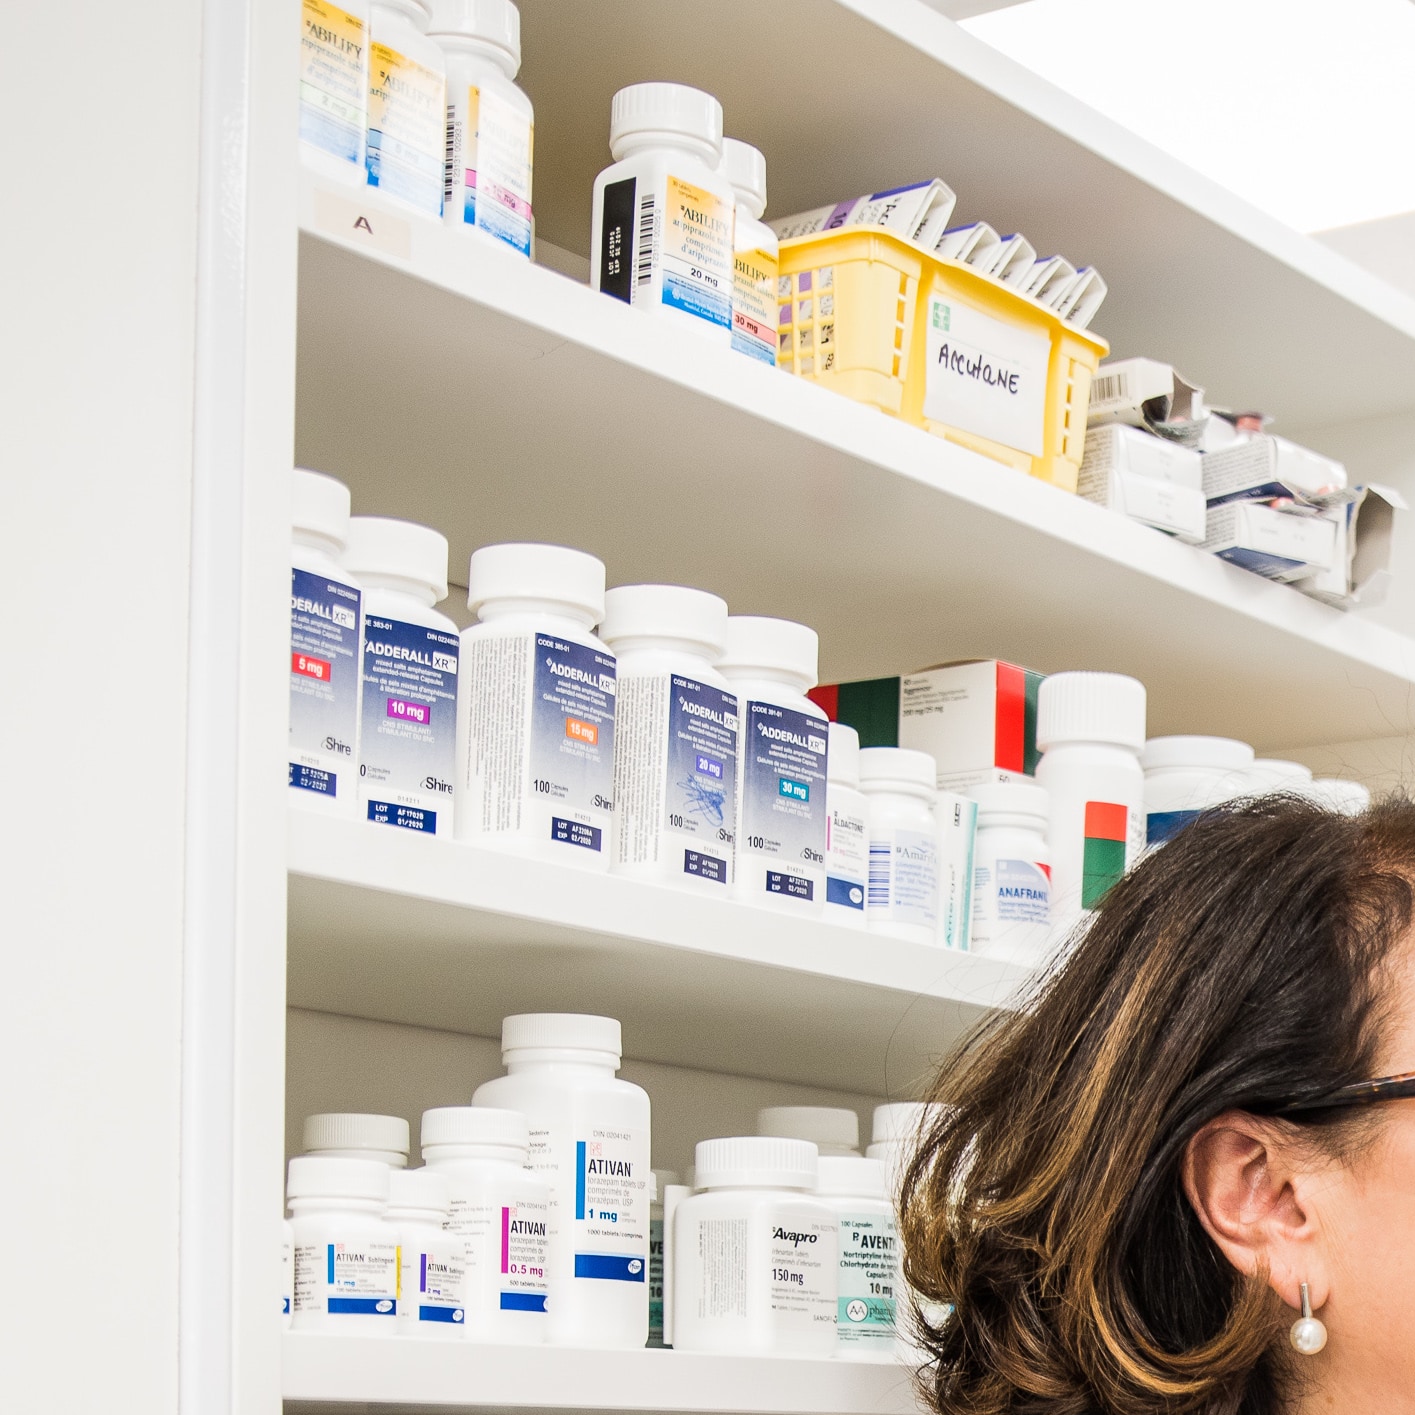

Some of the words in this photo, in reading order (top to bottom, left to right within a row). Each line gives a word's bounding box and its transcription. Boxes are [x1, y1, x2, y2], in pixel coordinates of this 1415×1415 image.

[309, 23, 362, 58] ABILIFY
[353, 216, 374, 235] A
[683, 207, 729, 236] ABILIFY
[691, 267, 702, 279] 20
[704, 275, 718, 288] mg
[735, 258, 768, 283] BILIFY
[735, 312, 745, 325] 30
[746, 320, 758, 334] mg
[292, 596, 332, 620] DERALL
[334, 610, 347, 625] XR
[538, 638, 553, 649] CODE
[366, 640, 431, 666] ADDERALL
[434, 656, 449, 670] XR
[299, 656, 306, 671] 5
[307, 663, 323, 677] mg
[550, 662, 599, 688] ADDERALL
[392, 701, 405, 715] 10
[406, 706, 424, 721] mg
[682, 700, 724, 725] ADDERALL
[752, 705, 768, 714] CODE
[570, 722, 581, 735] 15
[581, 727, 594, 741] mg
[761, 726, 808, 748] ADDERALL
[325, 736, 351, 756] Shire
[699, 758, 708, 771] 20
[709, 763, 720, 777] mg
[426, 777, 453, 794] Shire
[533, 779, 550, 794] 100
[782, 781, 792, 793] 30
[793, 785, 806, 800] mg
[375, 804, 388, 812] LOT
[375, 814, 388, 823] EXP
[397, 818, 424, 829] 01/2020
[557, 821, 567, 830] LOT
[669, 813, 683, 828] 100
[833, 817, 863, 833] ALDACTONE
[557, 831, 567, 839] EXP
[719, 828, 734, 844] Shir
[747, 835, 764, 849] 100
[804, 847, 824, 864] Shire
[593, 1130, 605, 1138] DIN
[588, 1159, 631, 1177] ATIVAN
[587, 1177, 620, 1188] lorazepam
[620, 1178, 636, 1189] tablets
[587, 1186, 622, 1198] comprimés
[623, 1189, 630, 1197] de
[622, 1198, 634, 1206] USP
[589, 1209, 594, 1219] 1
[600, 1211, 618, 1222] mg
[510, 1221, 546, 1236] ATIVAN
[773, 1227, 818, 1248] Avapro
[336, 1253, 365, 1263] ATIVAN
[844, 1251, 881, 1260] Nortriptyline
[427, 1264, 447, 1273] ATIVAN
[510, 1263, 527, 1275] 0.5
[529, 1267, 543, 1278] mg
[840, 1261, 879, 1270] Chlorhydrate
[772, 1268, 789, 1281] 150
[790, 1272, 804, 1286] mg
[870, 1283, 880, 1295] 10
